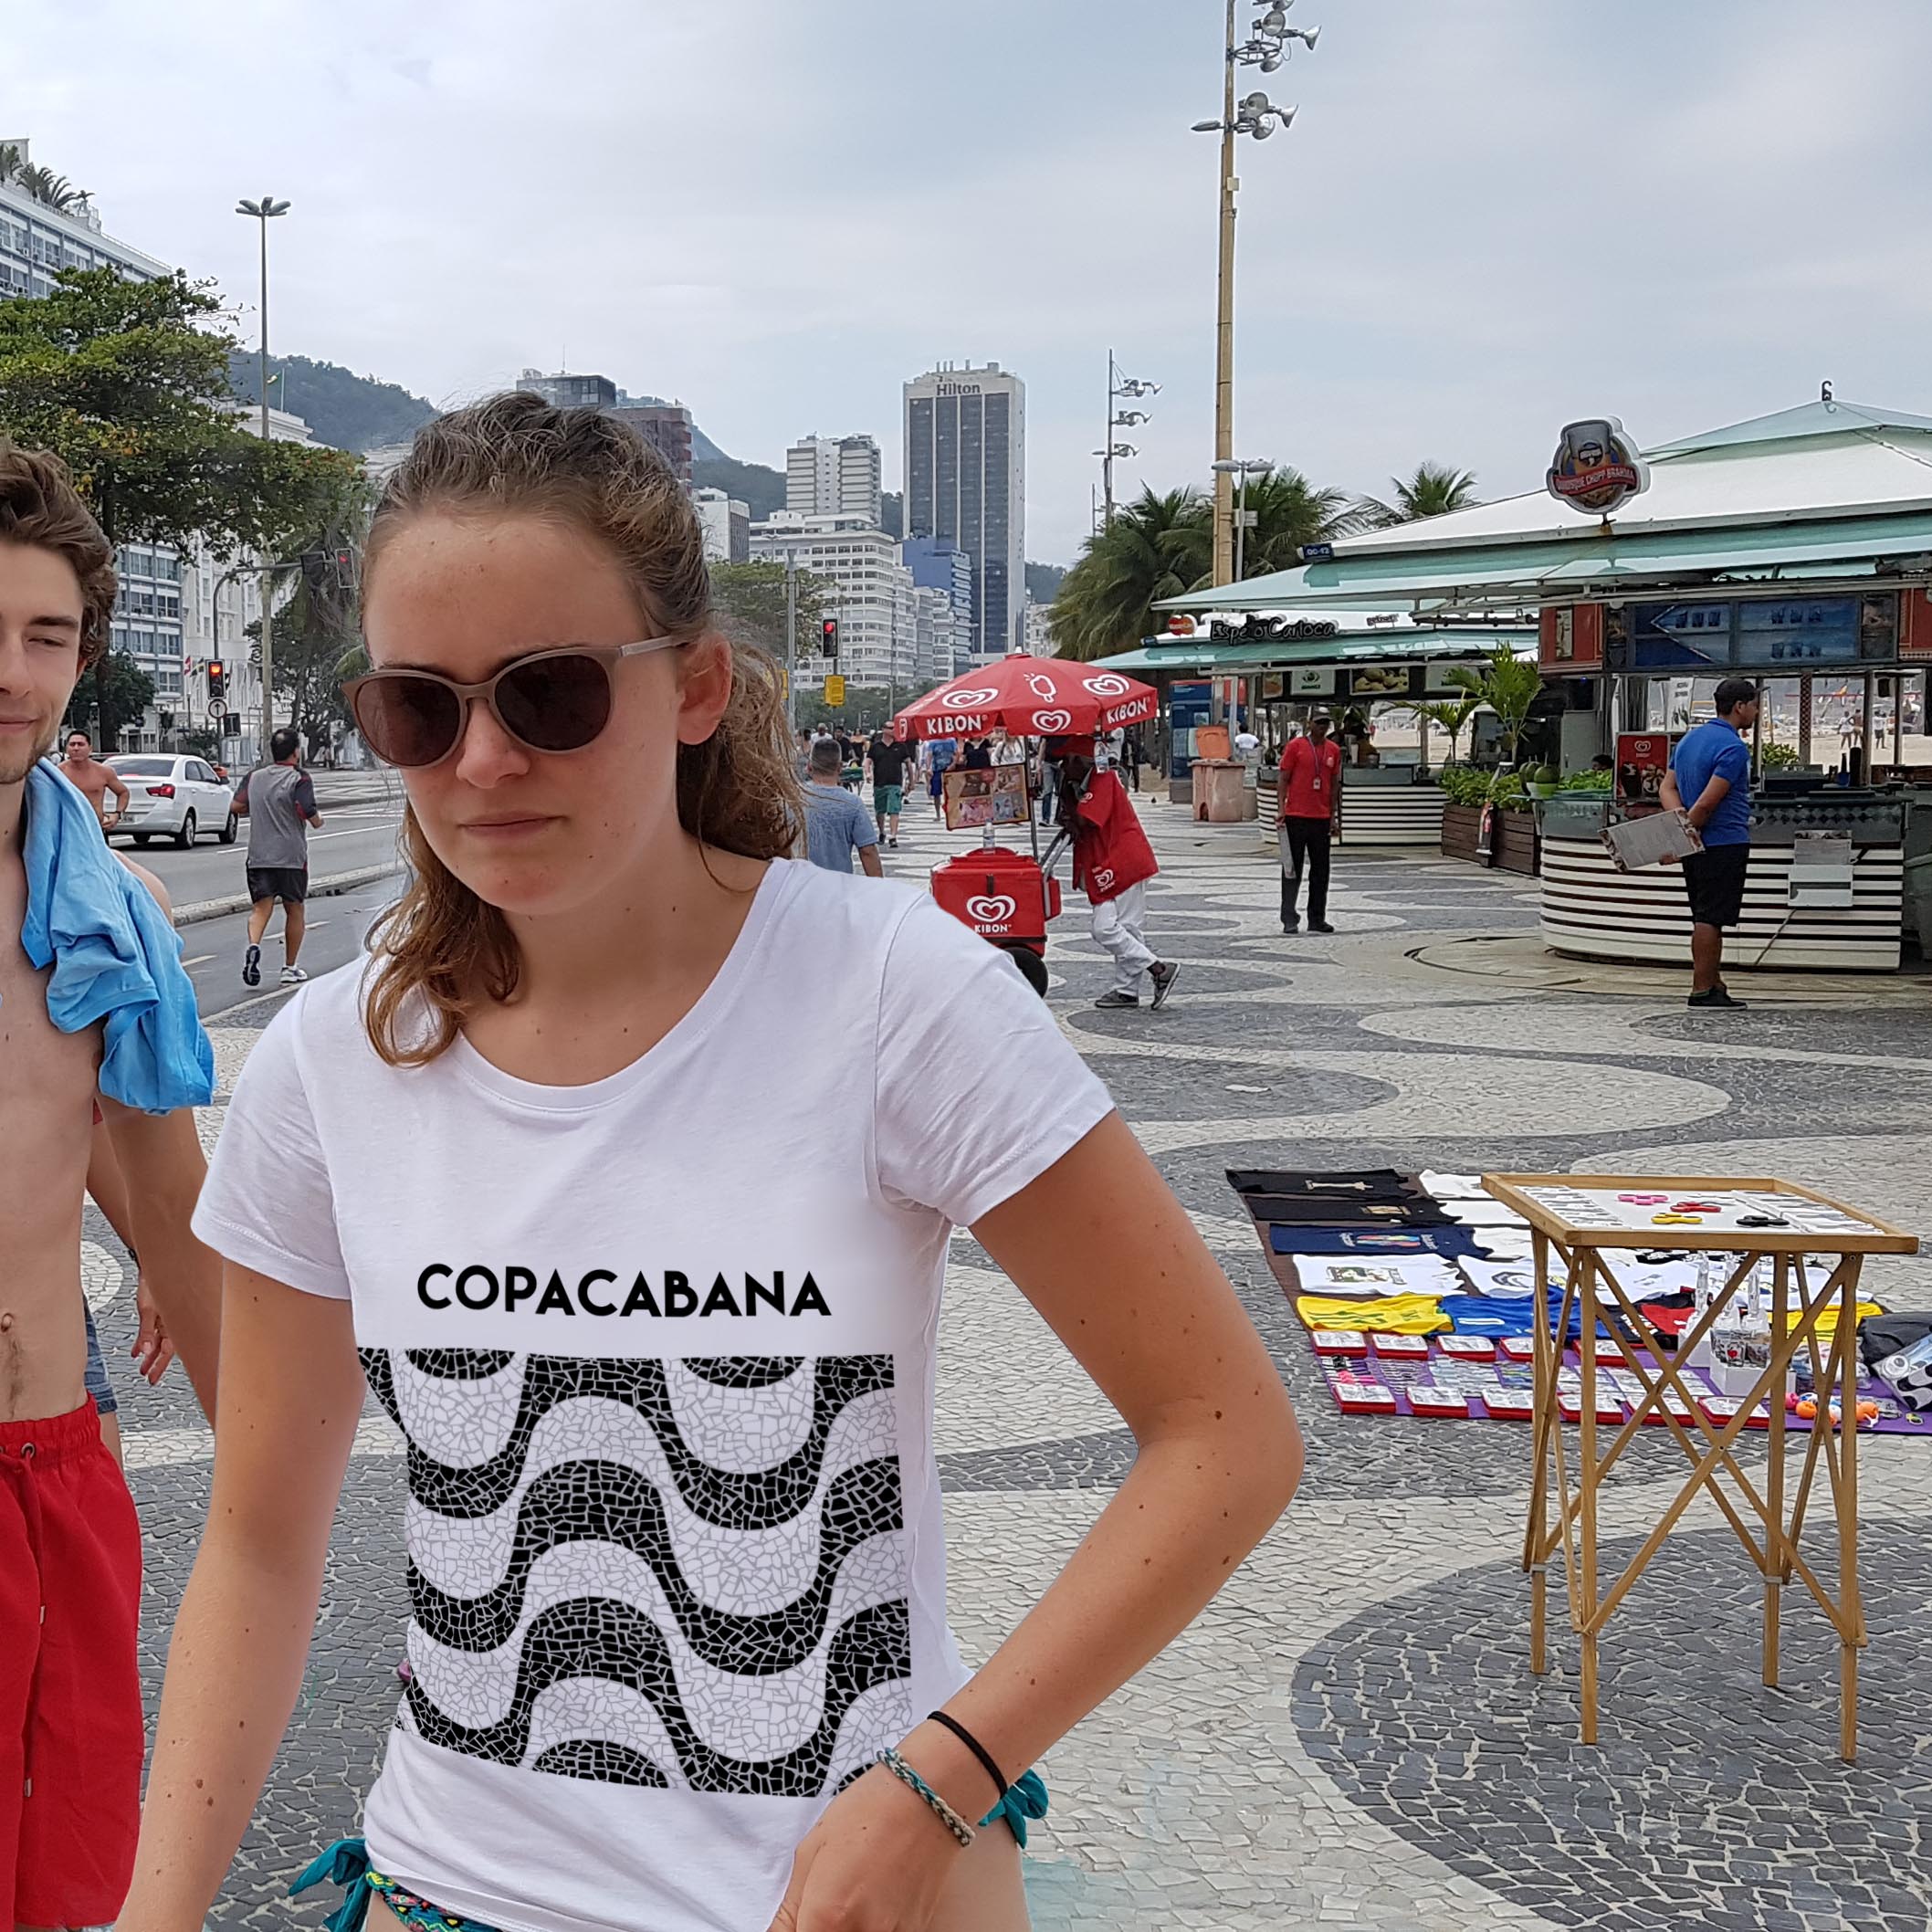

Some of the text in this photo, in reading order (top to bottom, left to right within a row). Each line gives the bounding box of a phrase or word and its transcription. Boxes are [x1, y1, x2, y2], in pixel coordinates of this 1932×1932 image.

[937, 383, 981, 395] Hilton
[1107, 699, 1149, 724] KIBON
[927, 716, 983, 734] KIBON
[974, 924, 1008, 933] KIBON
[417, 1263, 832, 1318] COPACABANA
